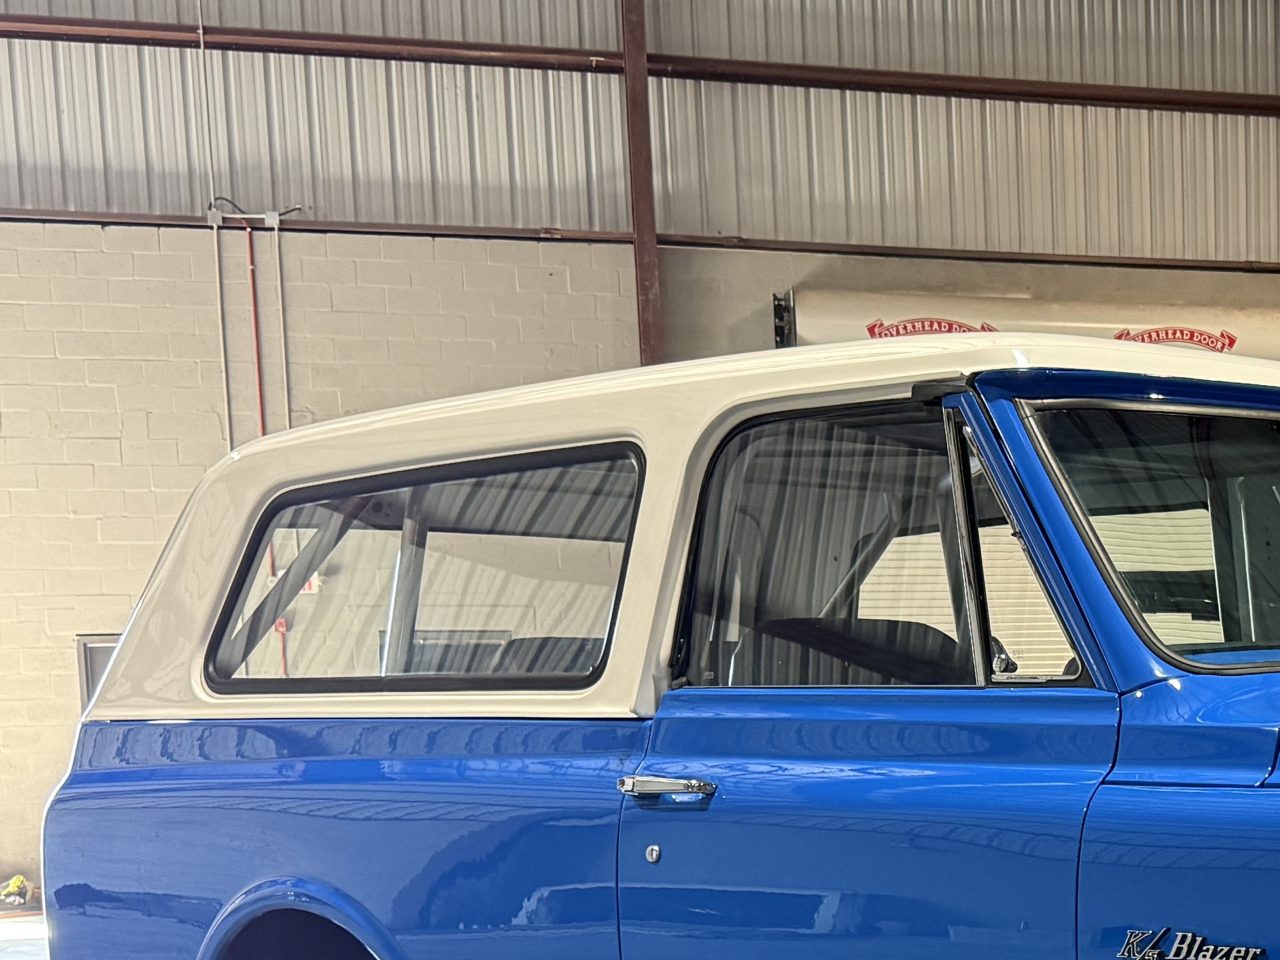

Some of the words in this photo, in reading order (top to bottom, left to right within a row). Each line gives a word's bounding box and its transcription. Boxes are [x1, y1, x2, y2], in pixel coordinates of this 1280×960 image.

[881, 320, 949, 337] OVERHEAD
[1131, 329, 1191, 343] VERHEAD
[1193, 332, 1223, 351] DOOR
